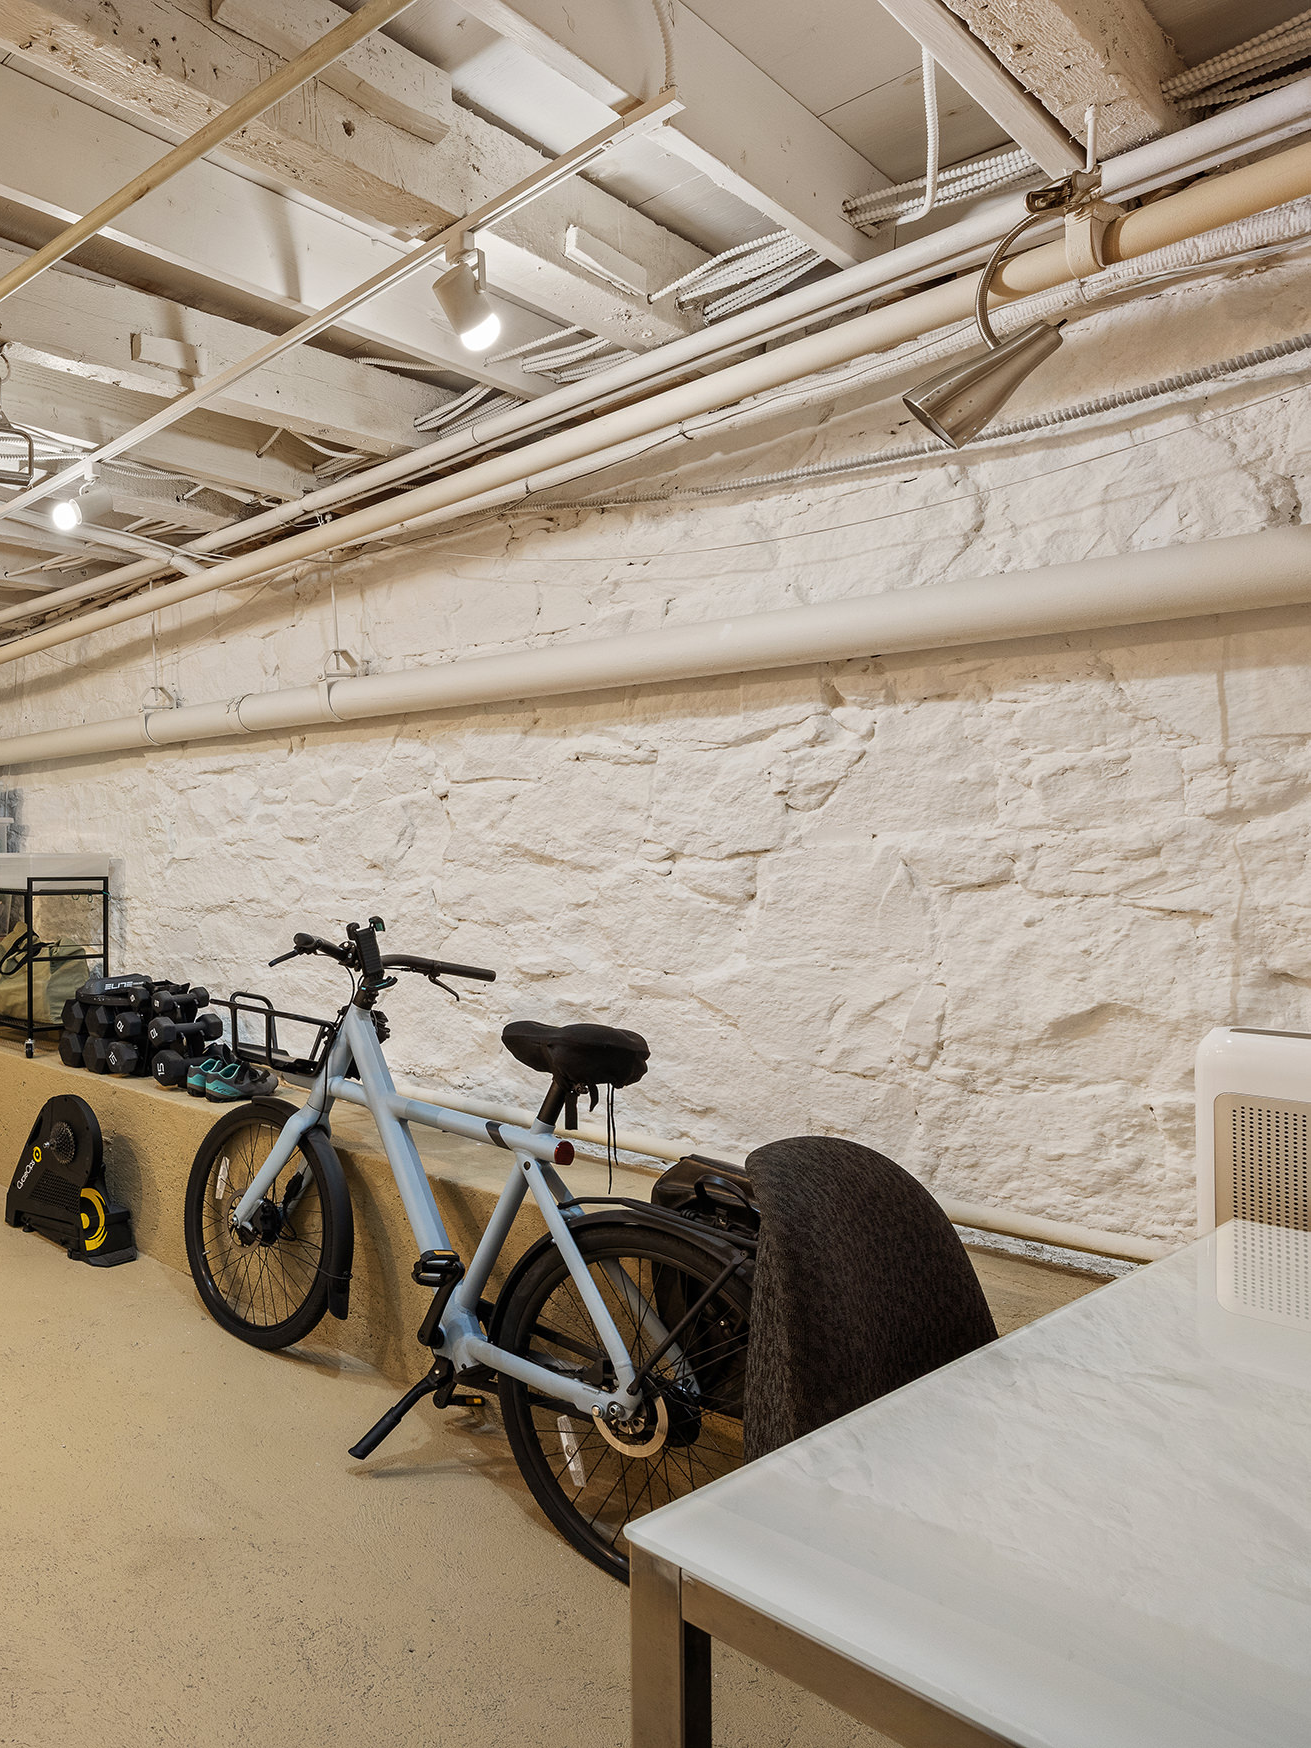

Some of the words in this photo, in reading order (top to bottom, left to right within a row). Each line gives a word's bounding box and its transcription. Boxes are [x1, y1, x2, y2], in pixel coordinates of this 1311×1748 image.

[116, 1020, 124, 1033] 10
[150, 1027, 158, 1039] 10
[108, 1051, 118, 1065] 15
[156, 1062, 165, 1076] 15
